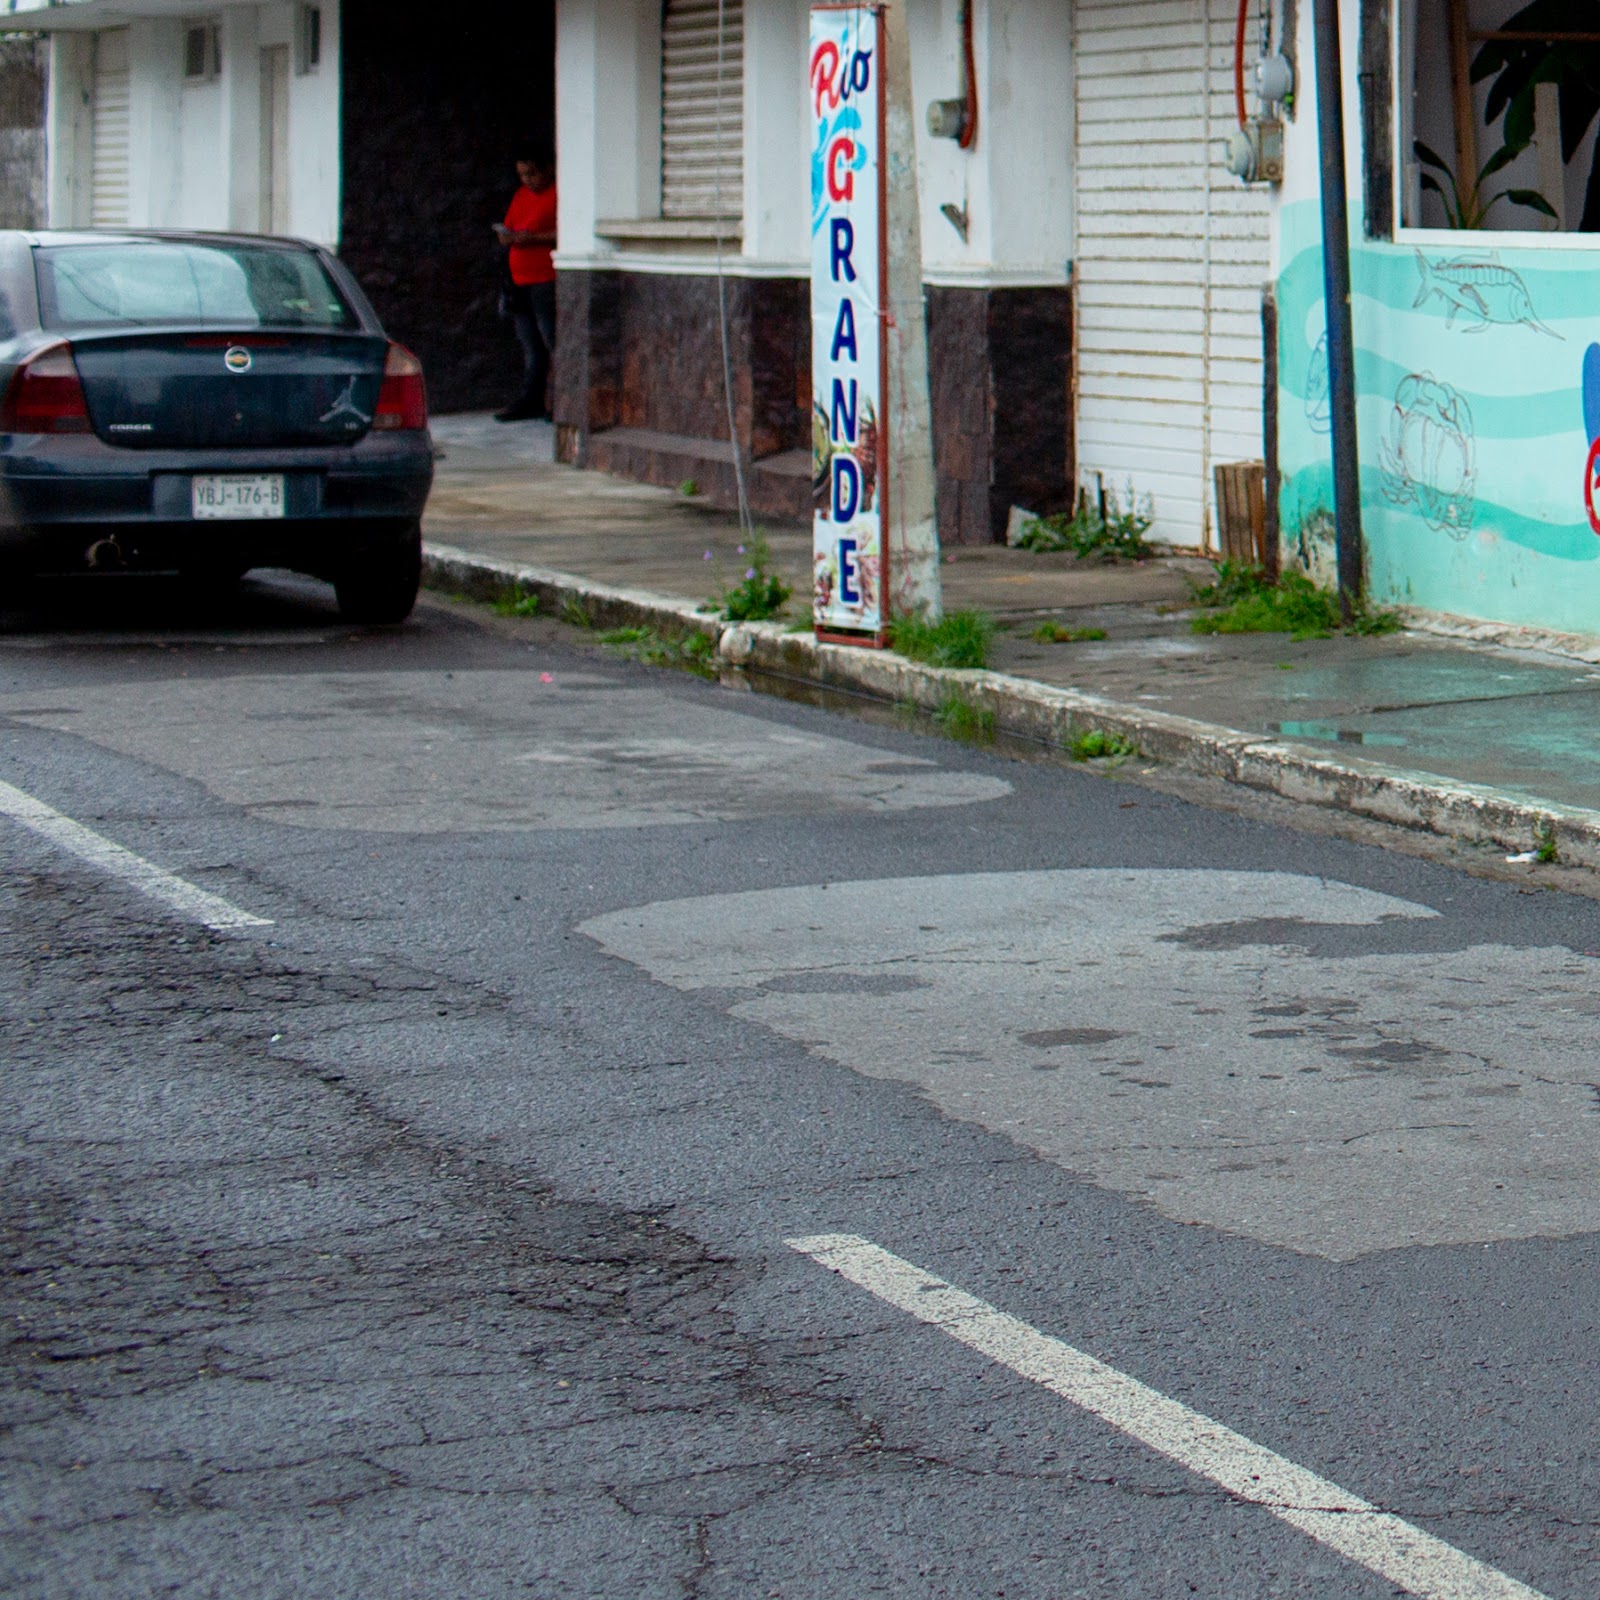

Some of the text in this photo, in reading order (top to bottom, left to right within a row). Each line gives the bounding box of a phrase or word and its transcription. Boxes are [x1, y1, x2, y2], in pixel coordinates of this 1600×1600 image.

[810, 40, 873, 119] Rio
[828, 137, 861, 603] GRANDE
[197, 486, 280, 506] YBJ-176-B
